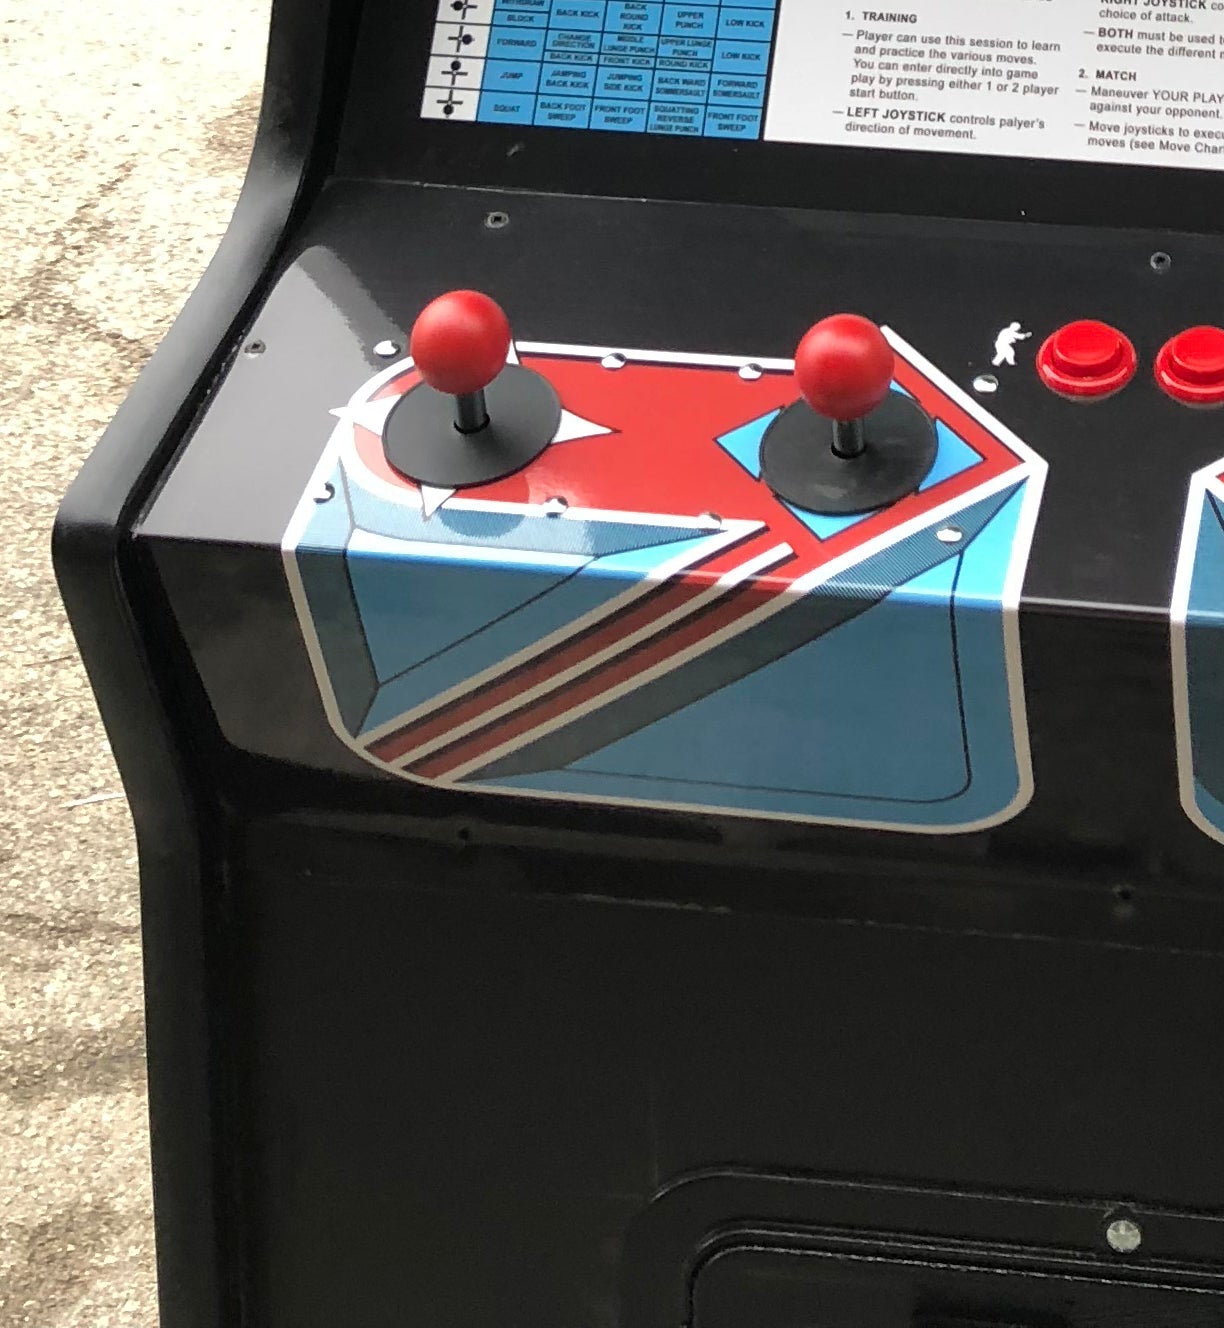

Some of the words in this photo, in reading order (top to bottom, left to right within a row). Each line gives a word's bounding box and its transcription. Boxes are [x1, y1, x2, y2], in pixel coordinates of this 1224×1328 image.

[845, 11, 855, 21] 1.
[862, 11, 918, 24] TRAINING
[1099, 8, 1136, 20] choice
[1140, 11, 1152, 21] of
[1155, 12, 1193, 23] attack.
[857, 29, 893, 43] Player
[896, 34, 917, 43] can
[921, 36, 941, 45] use
[945, 35, 965, 46] this
[970, 38, 1013, 49] session
[1017, 40, 1028, 50] to
[1032, 40, 1061, 51] learn
[1098, 27, 1133, 39] BOTH
[1137, 31, 1165, 42] must
[1169, 31, 1183, 42] be
[1187, 34, 1215, 44] used
[742, 53, 760, 61] KICK
[854, 45, 876, 56] and
[879, 47, 925, 60] practice
[929, 49, 947, 59] the
[950, 51, 992, 62] various
[996, 54, 1037, 65] moves.
[1096, 43, 1142, 55] execute
[1146, 45, 1163, 56] the
[1168, 46, 1215, 59] different
[854, 59, 874, 70] You
[878, 62, 898, 71] can
[902, 63, 932, 73] enter
[936, 63, 978, 77] directly
[982, 67, 1002, 77] into
[1006, 70, 1038, 81] game
[1078, 69, 1088, 79] 2.
[1096, 69, 1137, 82] MATCH
[851, 74, 875, 86] play
[879, 75, 892, 87] by
[896, 77, 944, 90] pressing
[949, 80, 981, 90] either
[987, 81, 992, 91] 1
[996, 84, 1008, 92] or
[1012, 83, 1019, 93] 2
[1023, 84, 1059, 96] player
[850, 88, 875, 99] start
[879, 90, 918, 101] button.
[1091, 86, 1148, 100] Maneuver
[1153, 89, 1189, 102] YOUR
[847, 107, 879, 119] LEFT
[882, 109, 946, 123] JOYSTICK
[950, 113, 995, 126] controls
[1090, 101, 1132, 114] against
[1136, 105, 1161, 117] your
[1165, 107, 1222, 119] opponent.
[845, 122, 894, 134] direction
[899, 125, 910, 135] of
[913, 127, 976, 139] movement.
[1089, 121, 1120, 133] Move
[1123, 123, 1174, 137] joysticks
[1178, 126, 1189, 137] to
[1088, 136, 1126, 148] moves
[1130, 138, 1155, 150] (see
[1159, 140, 1190, 152] Move
